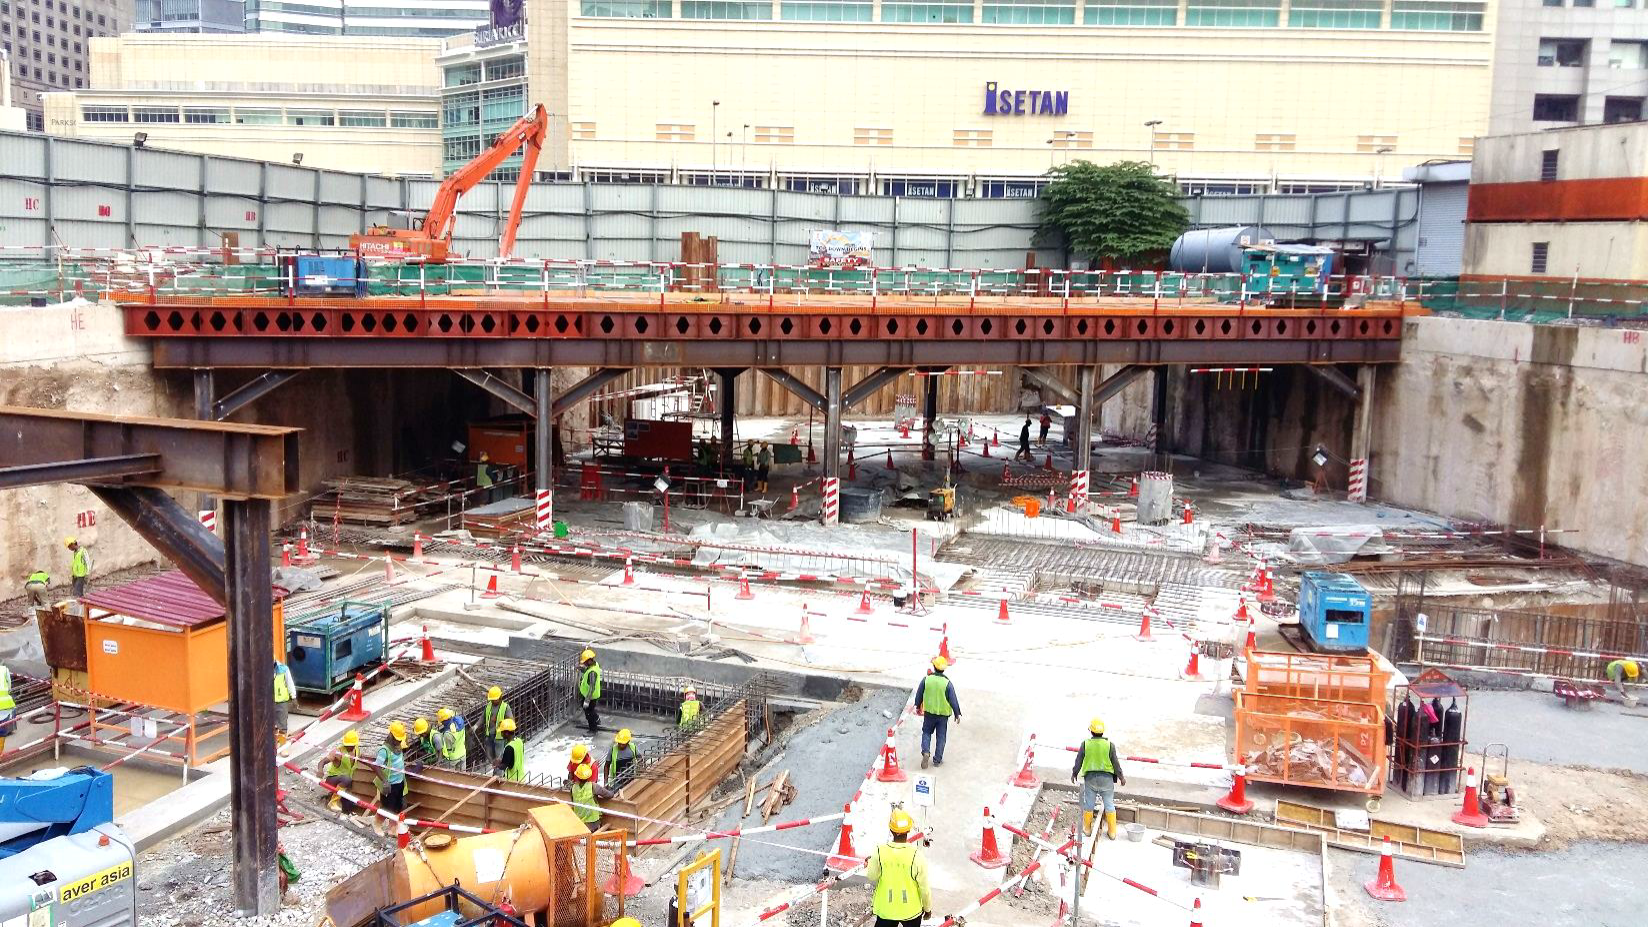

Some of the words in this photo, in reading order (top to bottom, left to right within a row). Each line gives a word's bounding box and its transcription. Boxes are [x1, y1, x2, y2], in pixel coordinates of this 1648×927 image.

[360, 242, 389, 250] HITACHI
[62, 878, 97, 901] aver
[100, 866, 130, 886] asia
